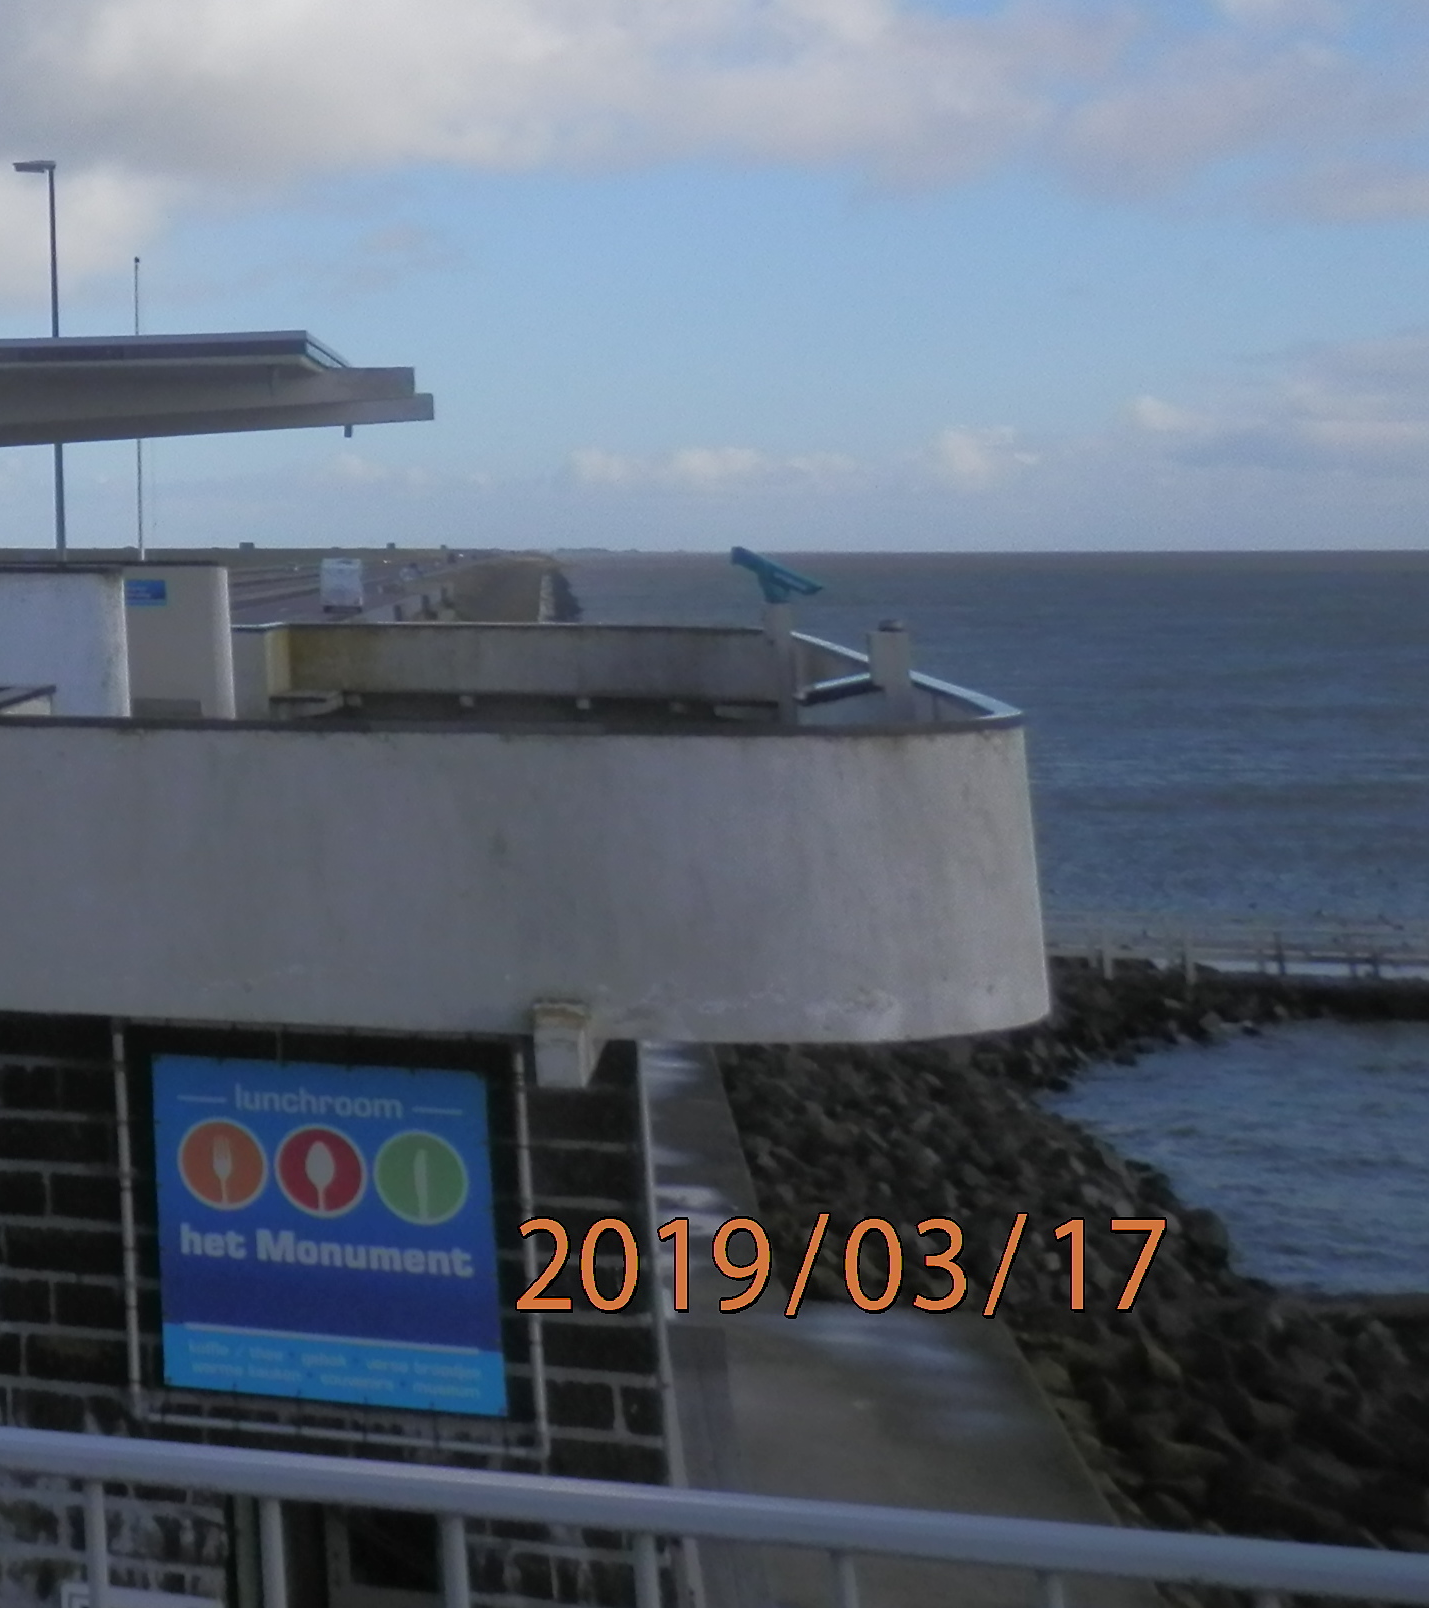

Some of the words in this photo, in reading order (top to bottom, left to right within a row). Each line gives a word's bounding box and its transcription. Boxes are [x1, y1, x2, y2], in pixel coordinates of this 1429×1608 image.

[235, 1083, 404, 1120] lunchroom
[179, 1222, 247, 1260] het
[255, 1228, 475, 1279] Monument
